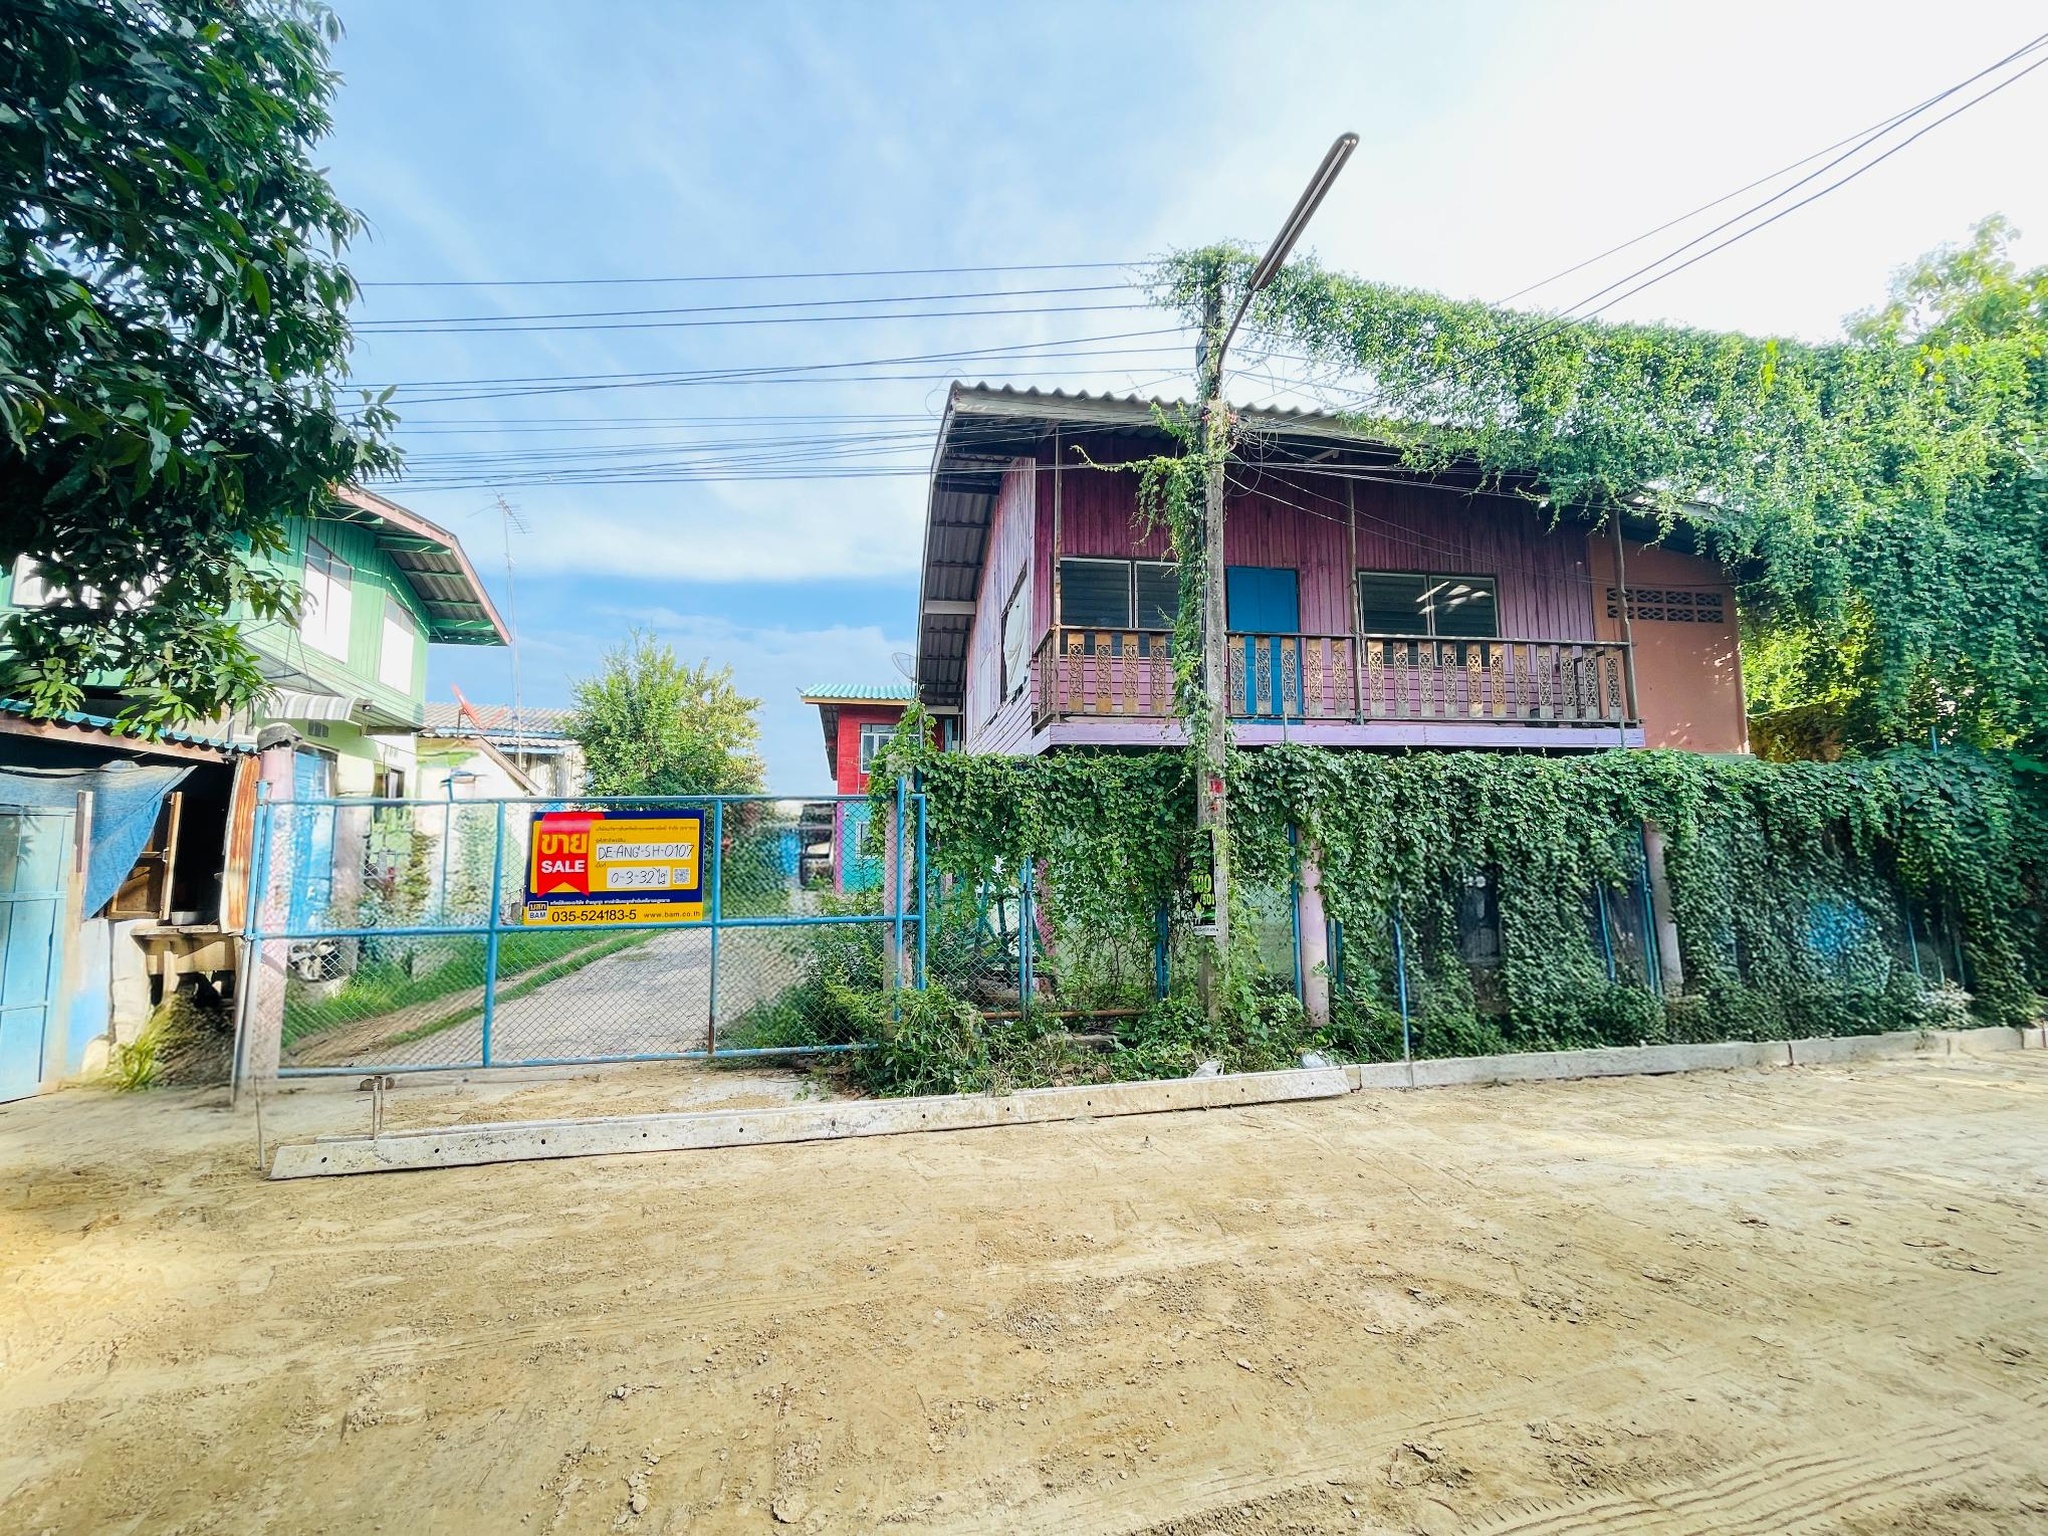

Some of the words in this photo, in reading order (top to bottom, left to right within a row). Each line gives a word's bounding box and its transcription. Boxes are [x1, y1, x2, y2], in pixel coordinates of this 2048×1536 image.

[541, 834, 588, 854] ขาย
[541, 860, 586, 874] SALE
[529, 911, 546, 919] BAM
[551, 909, 637, 922] 035-524183-5
[643, 910, 701, 918] www.bam.co.th
